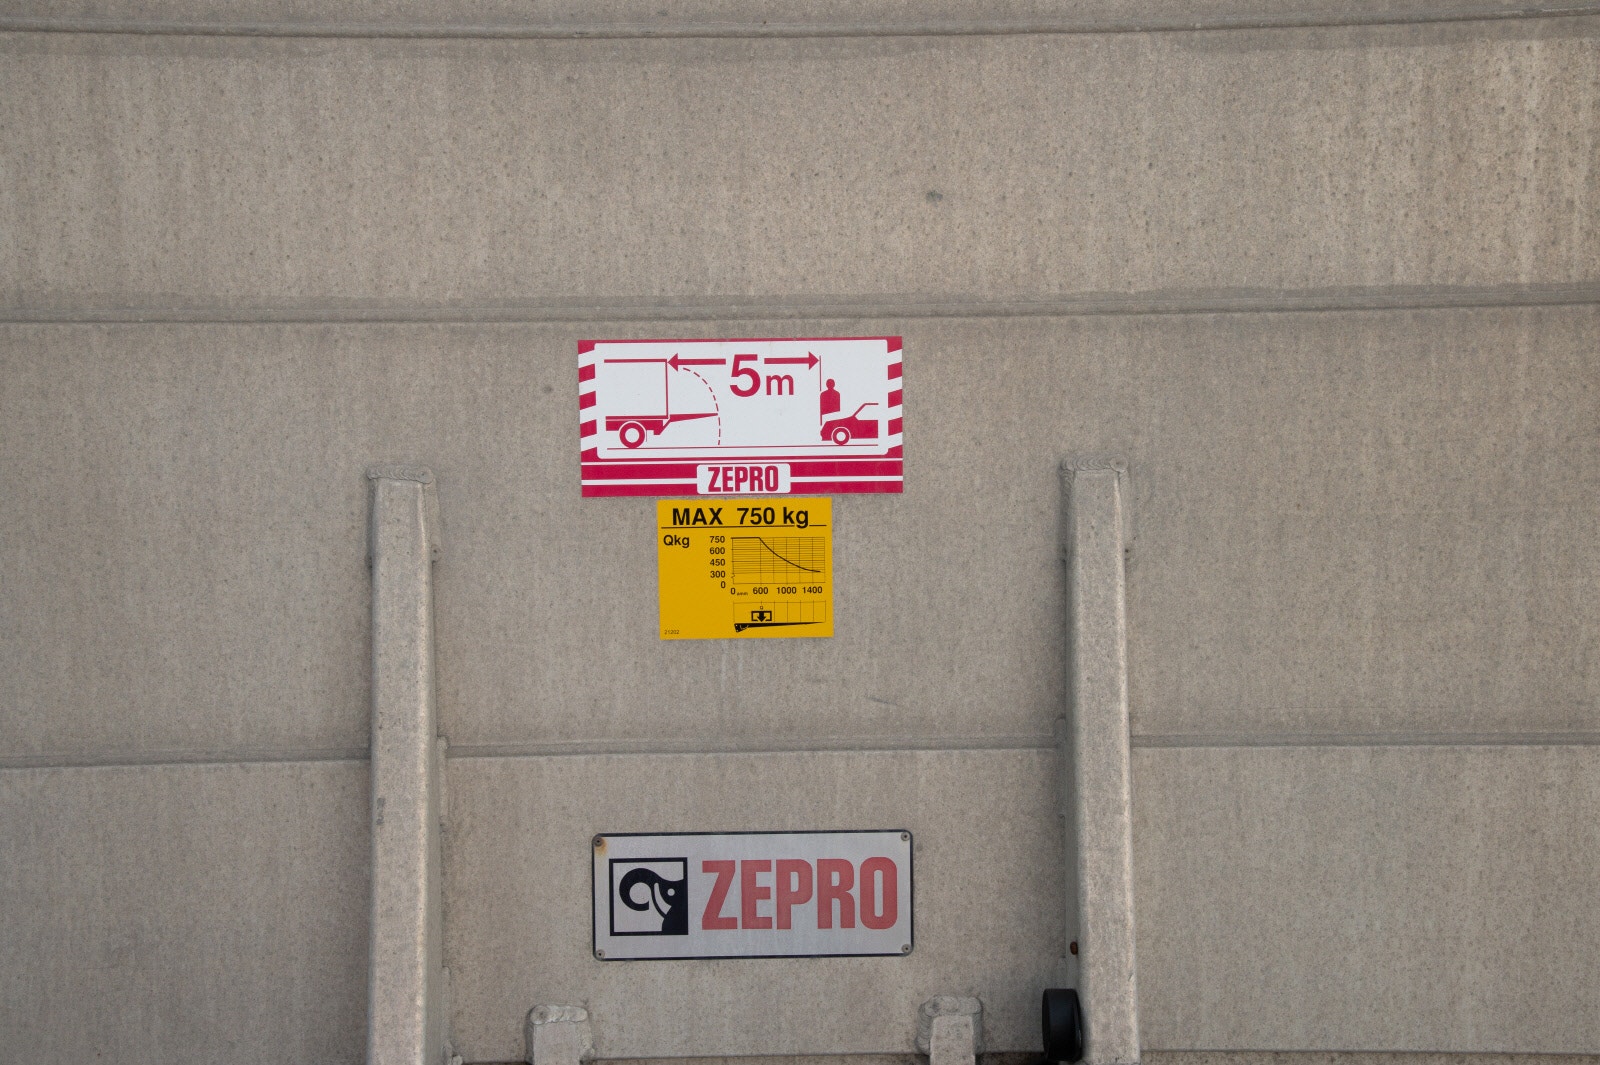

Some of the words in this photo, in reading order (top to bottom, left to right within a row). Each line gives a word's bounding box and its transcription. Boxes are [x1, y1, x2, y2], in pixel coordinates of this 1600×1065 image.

[708, 465, 779, 492] ZEPRO
[672, 508, 723, 526] MAX
[737, 507, 775, 525] 750
[783, 507, 809, 529] kg
[663, 534, 690, 549] Qkg
[709, 535, 726, 543] 750
[709, 547, 726, 555] 600
[709, 558, 726, 567] 450
[710, 570, 726, 578] 300
[720, 580, 726, 589] 0
[730, 587, 736, 595] 0
[752, 586, 769, 595] 600
[776, 586, 797, 595] 1000
[802, 586, 823, 594] 1400
[701, 856, 898, 930] ZEPRO
